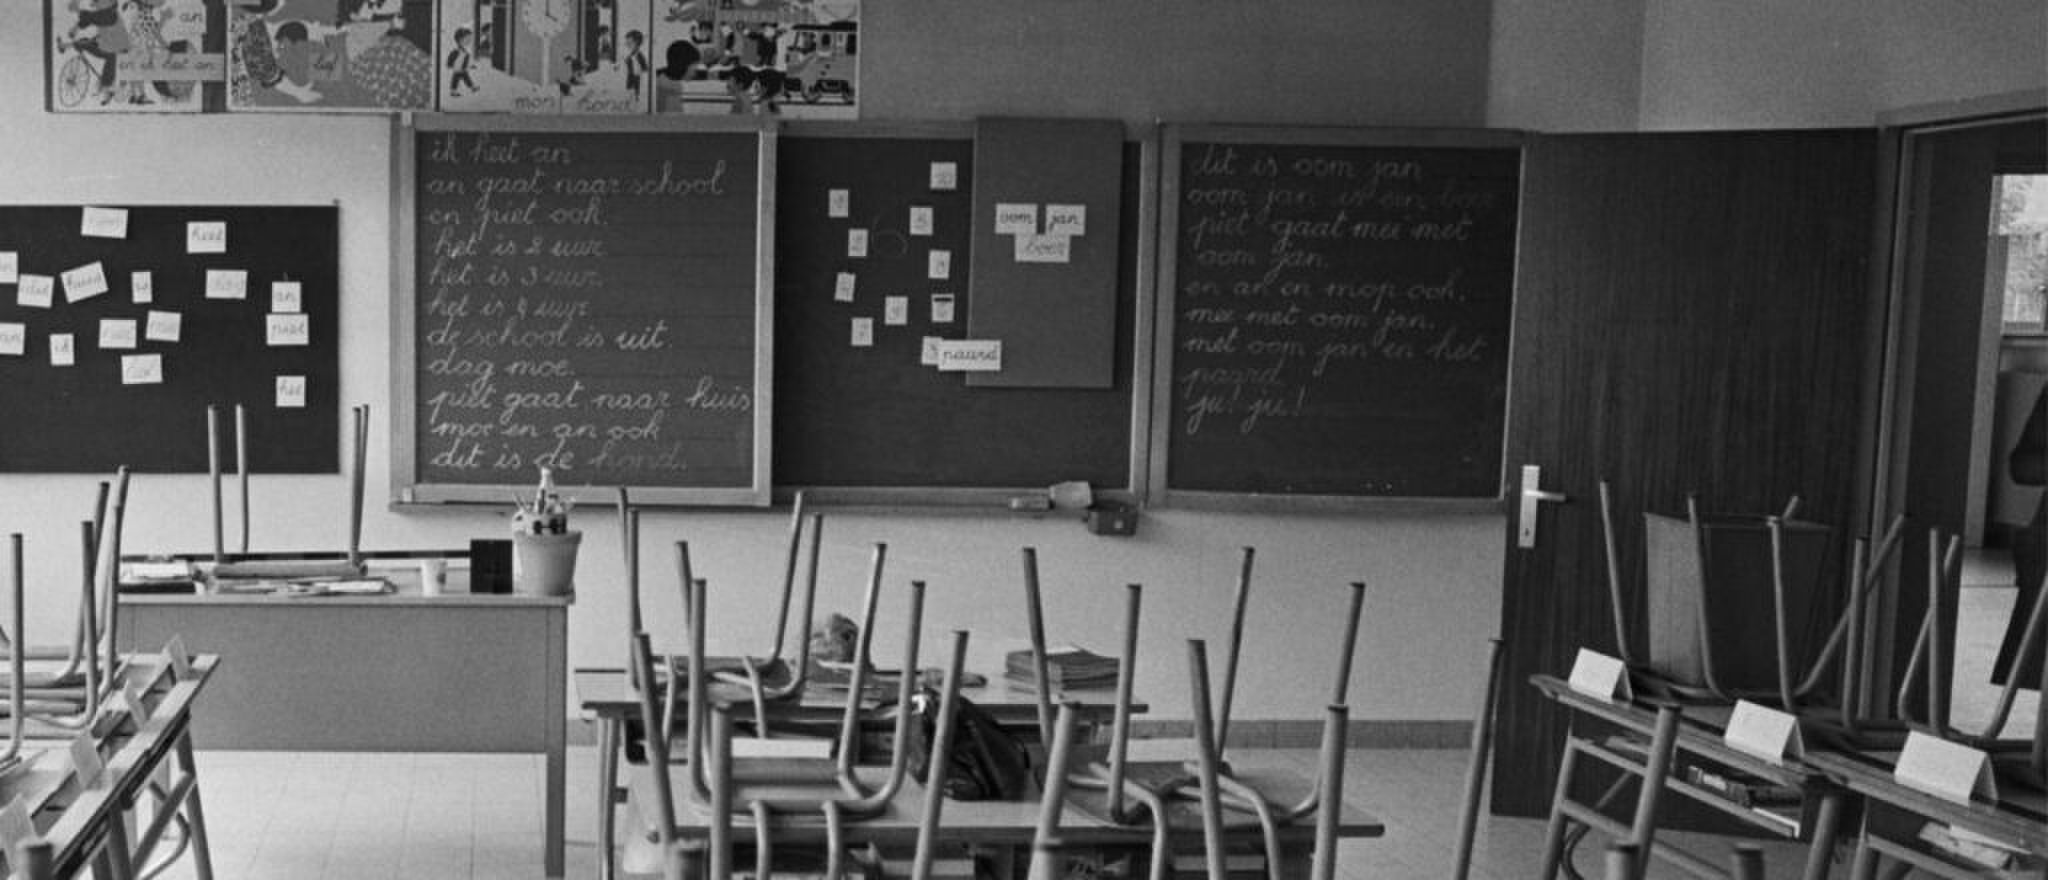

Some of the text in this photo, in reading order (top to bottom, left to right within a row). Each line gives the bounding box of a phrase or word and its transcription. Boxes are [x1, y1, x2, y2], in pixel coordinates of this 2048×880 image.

[430, 132, 572, 166] ik heet an
[427, 160, 727, 210] an gaat naar school
[1191, 146, 1423, 194] dit is oom jan
[427, 206, 461, 226] en
[475, 199, 538, 242] piet
[1186, 188, 1248, 208] oom
[1255, 187, 1315, 224] jan
[433, 226, 478, 259] het
[1187, 209, 1248, 251] piet
[1270, 210, 1348, 255] gaat
[1410, 212, 1473, 240] met
[429, 258, 472, 287] het
[488, 263, 511, 287] is
[1197, 248, 1256, 267] oom
[428, 288, 469, 318] het
[480, 294, 504, 318] is
[1183, 280, 1221, 298] en
[1232, 279, 1268, 298] an
[1279, 280, 1311, 298] en
[1325, 280, 1395, 313] mop
[427, 315, 458, 347] de
[466, 316, 567, 347] school
[577, 326, 606, 348] is
[1246, 303, 1302, 326] met
[1308, 312, 1368, 329] oom
[1184, 327, 1240, 353] met
[1247, 339, 1306, 358] oom
[1311, 342, 1368, 377] jan
[427, 348, 495, 394] dag
[427, 376, 751, 425] piet gaat naar huis
[500, 421, 538, 438] en
[550, 421, 598, 439] an
[431, 438, 485, 468] dit
[494, 446, 521, 470] is
[534, 439, 575, 469] de
